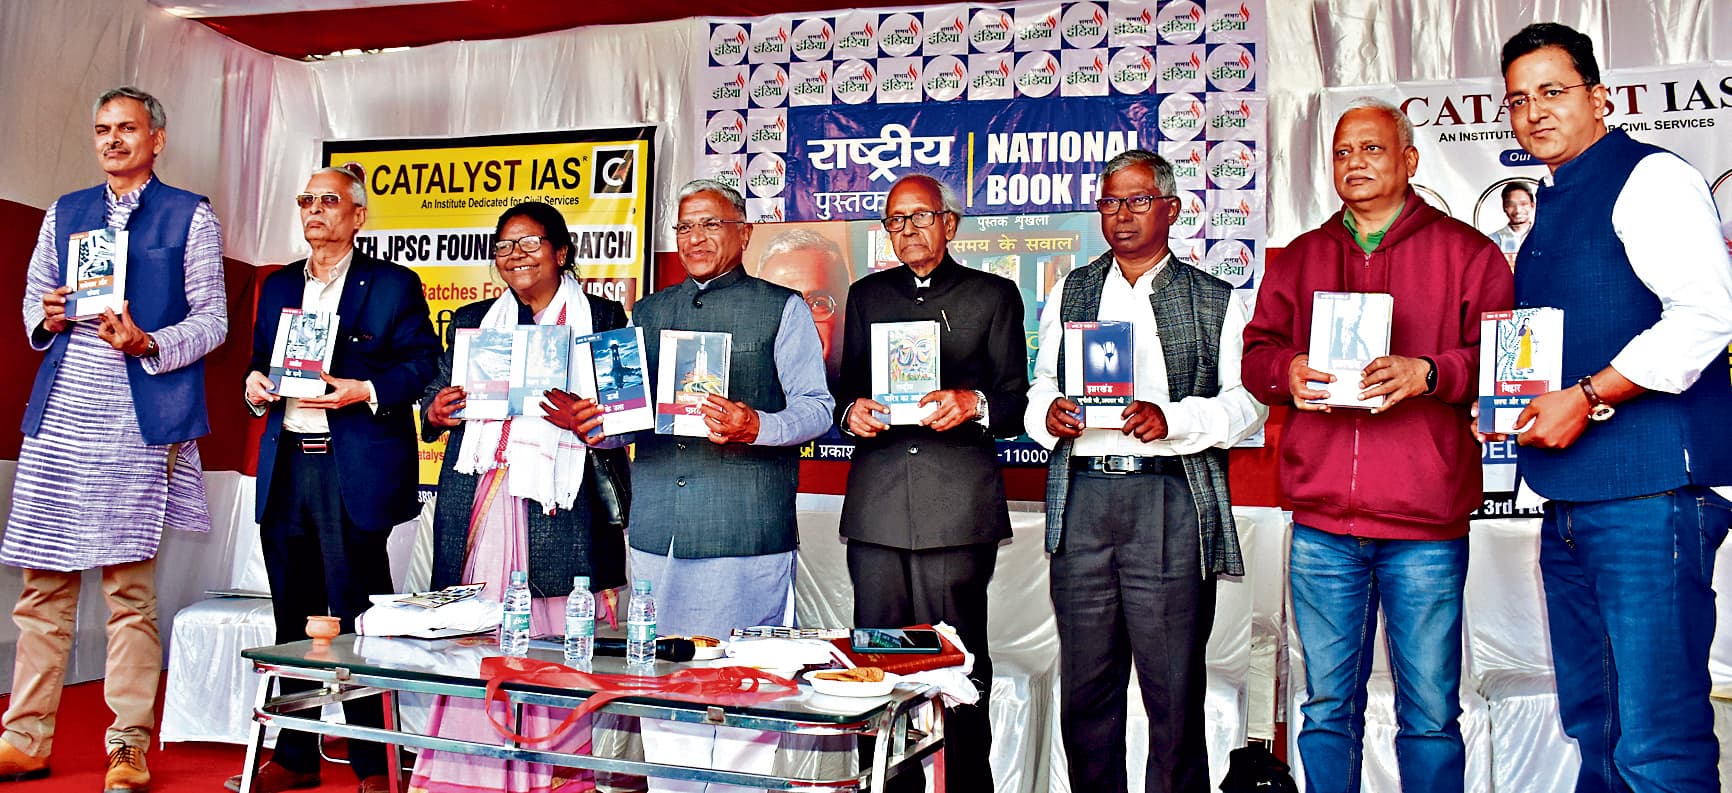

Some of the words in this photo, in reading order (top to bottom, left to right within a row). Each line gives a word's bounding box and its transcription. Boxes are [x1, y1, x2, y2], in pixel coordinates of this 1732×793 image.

[1067, 24, 1099, 37] इंडिया
[1114, 22, 1146, 34] इंडिया
[1162, 19, 1196, 32] इंडिया
[1212, 18, 1246, 32] इंडिया
[883, 33, 914, 46] इंडिया
[928, 31, 960, 44] इंडिया
[974, 28, 1005, 42] इंडिया
[1020, 26, 1052, 40] इंडिया
[753, 40, 783, 53] इंडिया
[796, 39, 826, 51] इंडिया
[839, 35, 869, 48] इंडिया
[715, 42, 741, 56] इंडिया
[1020, 72, 1052, 86] इंडिया
[1067, 71, 1099, 84] इंडिया
[1114, 69, 1147, 83] इंडिया
[1162, 66, 1196, 80] इंडिया
[1212, 66, 1246, 80] इंडिया
[838, 80, 868, 94] इंडिया
[882, 78, 914, 92] इंडिया
[928, 76, 958, 90] इंडिया
[973, 74, 1004, 88] इंडिया
[712, 86, 741, 99] इंडिया
[753, 85, 782, 98] इंडिया
[794, 82, 824, 95] इंडिया
[1660, 76, 1732, 112] IAS
[1162, 116, 1196, 128] इंडिया
[1212, 114, 1246, 128] इंडिया
[1620, 122, 1651, 132] CIVIL
[1654, 118, 1715, 130] SERVICES
[712, 130, 740, 144] इंडिया
[752, 129, 781, 142] इंडिया
[1439, 132, 1455, 143] AN
[1460, 130, 1516, 142] INSTITUTE
[807, 123, 955, 183] राष्ट्रीय
[1509, 152, 1531, 162] Our
[1212, 164, 1246, 177] इंडिया
[371, 160, 522, 196] CATALYST
[751, 174, 779, 186] इंडिया
[987, 174, 1073, 205] BOOK
[421, 199, 432, 209] An
[434, 198, 466, 209] Institute
[468, 197, 508, 208] Dedicated
[510, 196, 521, 206] for
[544, 196, 579, 205] Services
[977, 216, 1008, 231] पुस्तक
[1212, 214, 1246, 226] इंडिया
[356, 236, 377, 258] TH
[383, 234, 431, 261] JPSC
[436, 234, 496, 261] FOUND
[952, 240, 990, 253] समय
[998, 234, 1018, 251] के
[1212, 264, 1244, 276] इंडिया
[418, 449, 444, 463] atalys
[818, 445, 856, 459] प्रकाश
[997, 449, 1049, 463] -11000
[1484, 499, 1512, 514] 3rd
